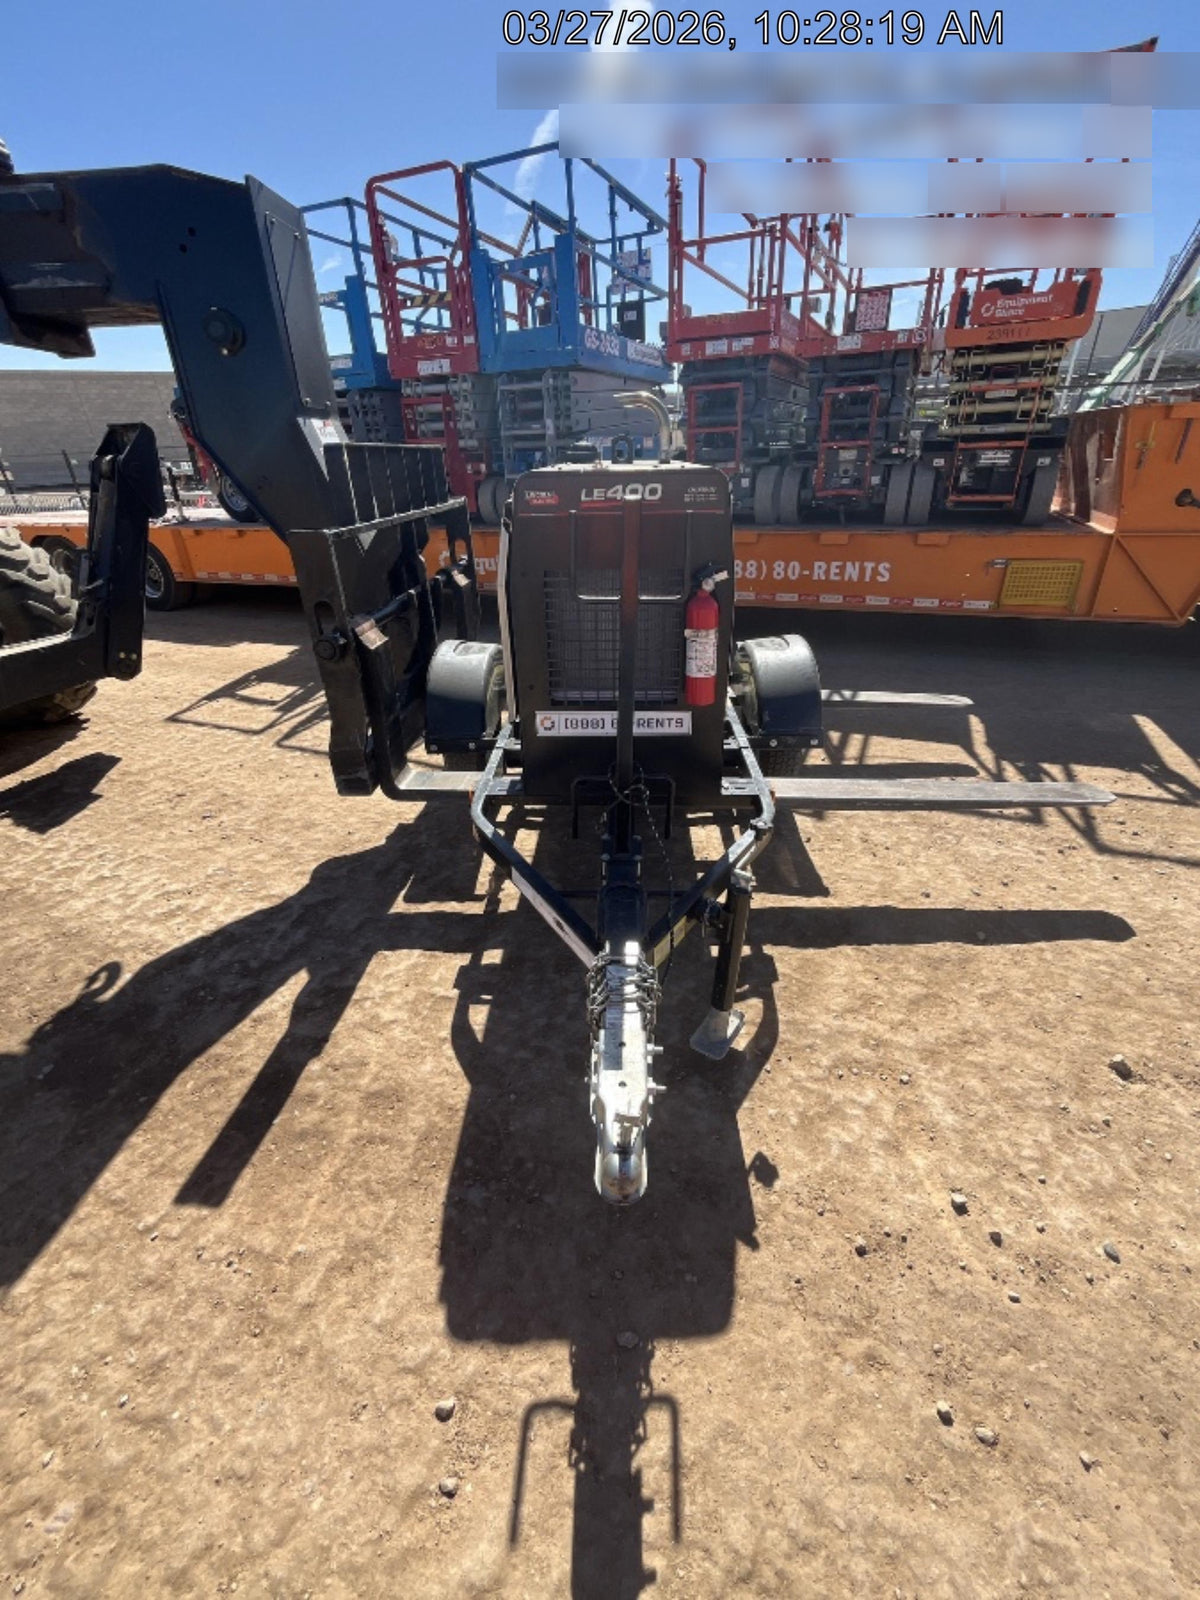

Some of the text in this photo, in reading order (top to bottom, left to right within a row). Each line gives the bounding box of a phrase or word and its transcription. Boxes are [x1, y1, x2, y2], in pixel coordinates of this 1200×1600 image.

[581, 483, 663, 501] LE400
[734, 560, 891, 583] 88) 80-RENTS
